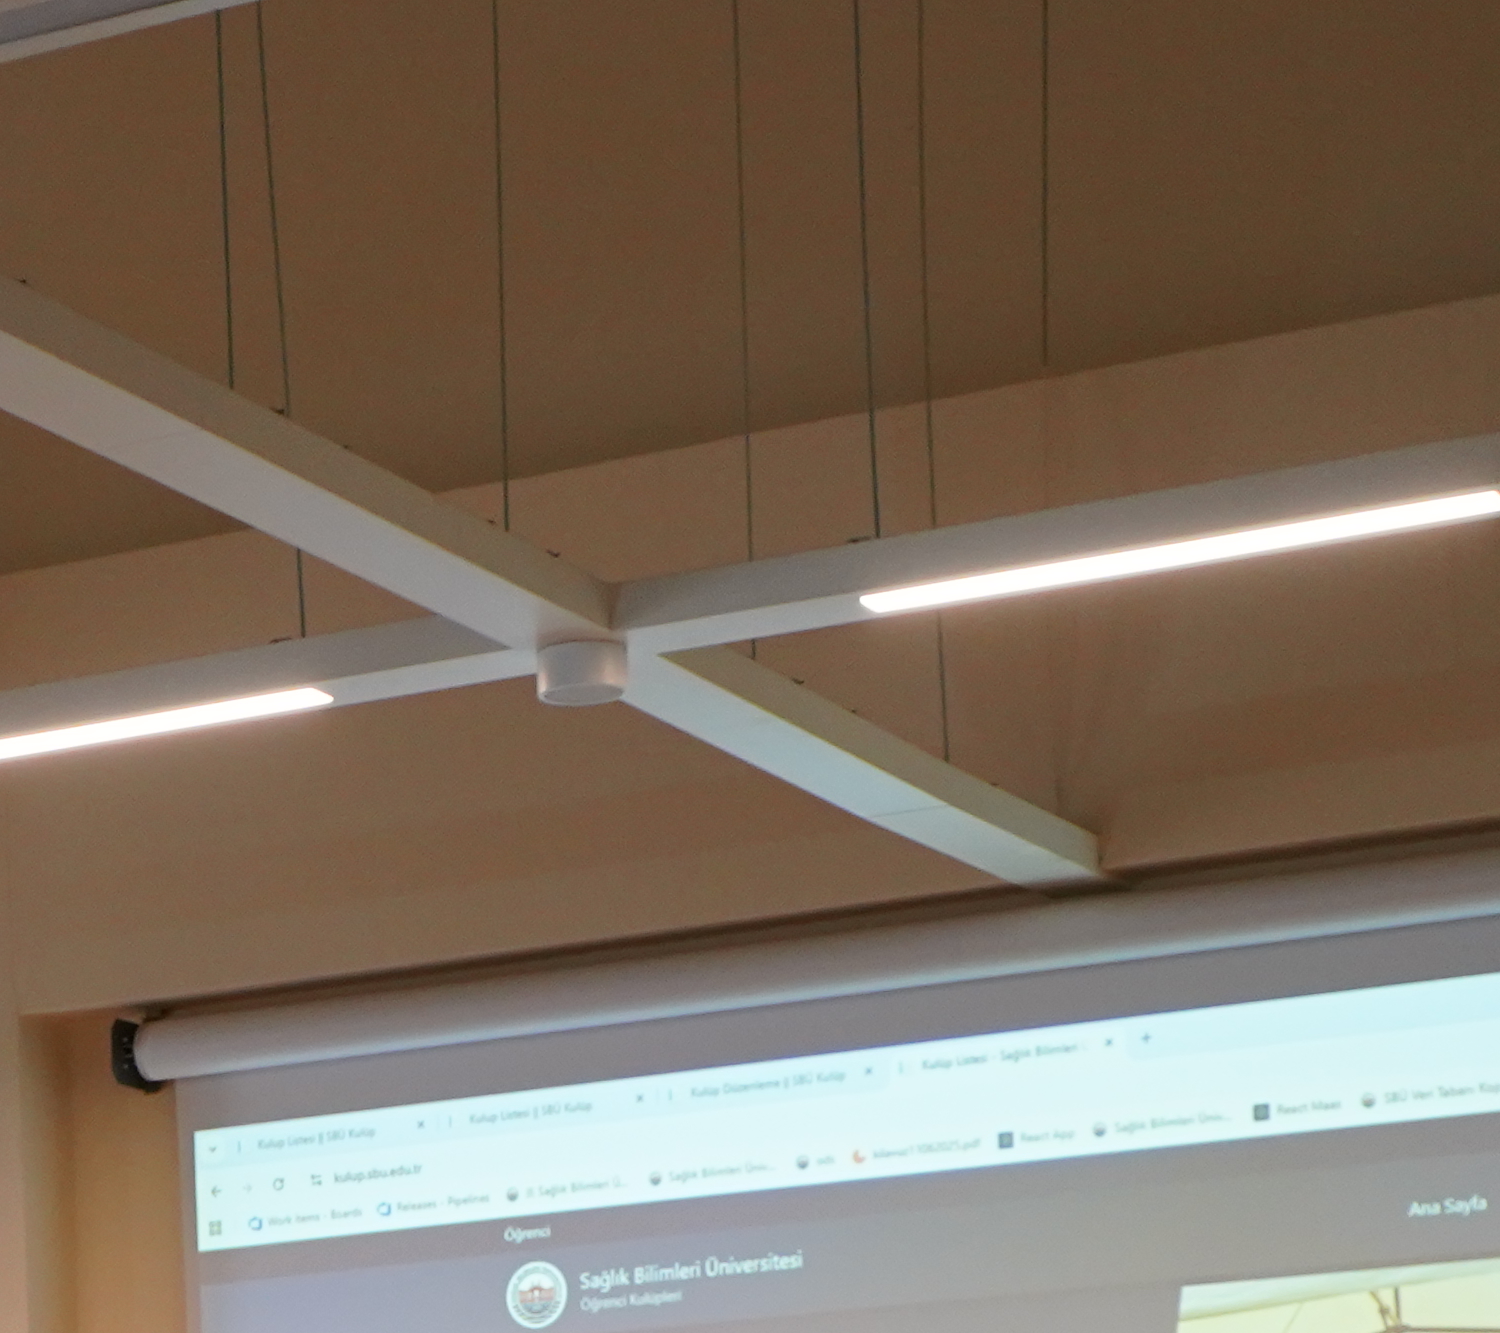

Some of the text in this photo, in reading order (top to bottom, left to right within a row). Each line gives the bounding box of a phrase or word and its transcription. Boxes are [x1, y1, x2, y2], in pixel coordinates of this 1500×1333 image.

[333, 1164, 422, 1184] kulup.sbu.edu.tr
[1408, 1195, 1488, 1217] Ana Sayfa
[504, 1227, 551, 1244] Öğrenci
[579, 1250, 803, 1292] Sağlık Bilimleri Üniversitesi
[580, 1291, 628, 1313] Öğrenci
[629, 1291, 682, 1306] Kulüpleri
